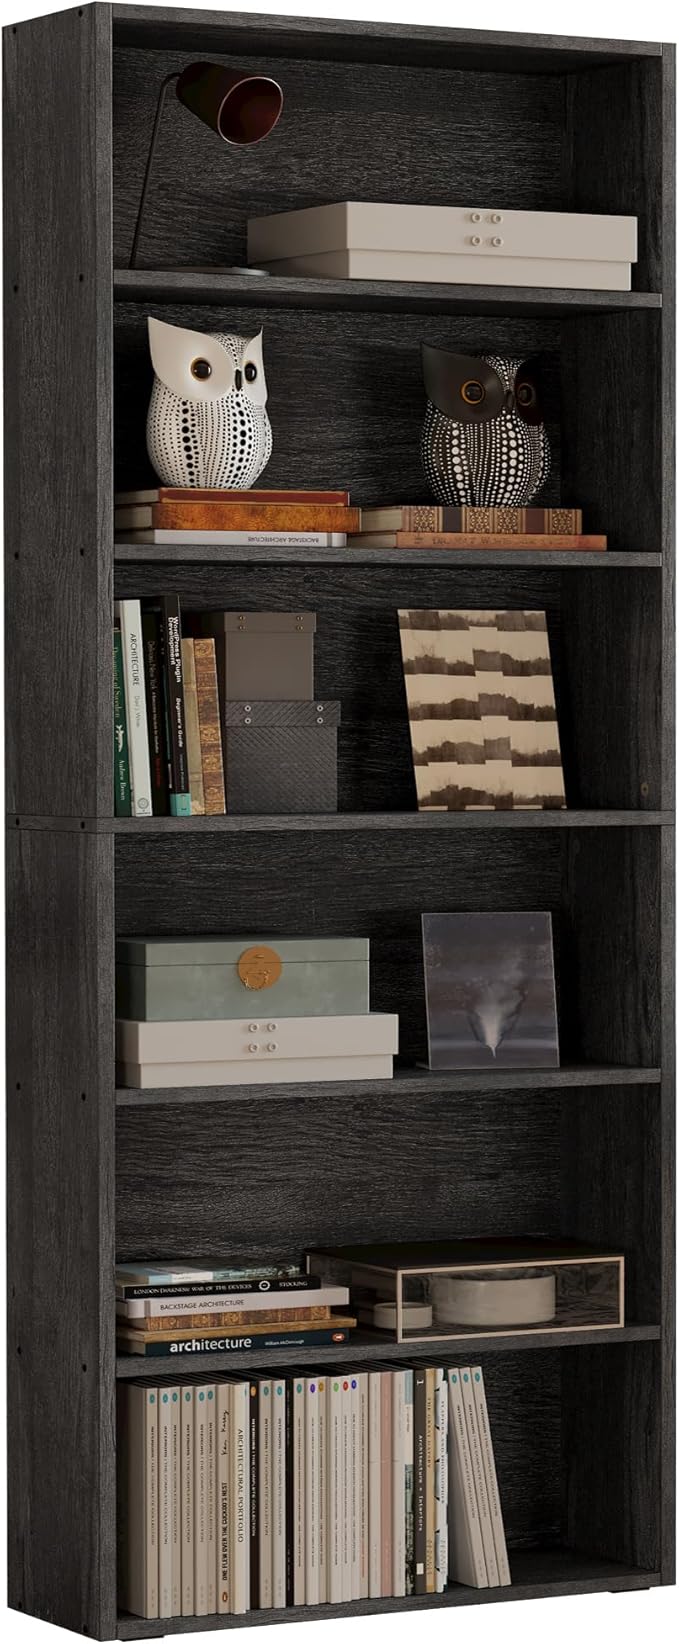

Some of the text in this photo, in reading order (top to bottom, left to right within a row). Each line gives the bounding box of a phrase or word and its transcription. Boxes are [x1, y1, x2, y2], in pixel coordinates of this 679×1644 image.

[130, 634, 139, 686] ARCHITECTURE
[113, 691, 122, 718] Sweden
[118, 760, 126, 780] Andrew
[198, 1300, 244, 1308] ARCHITECTURE
[169, 1337, 252, 1353] architecture
